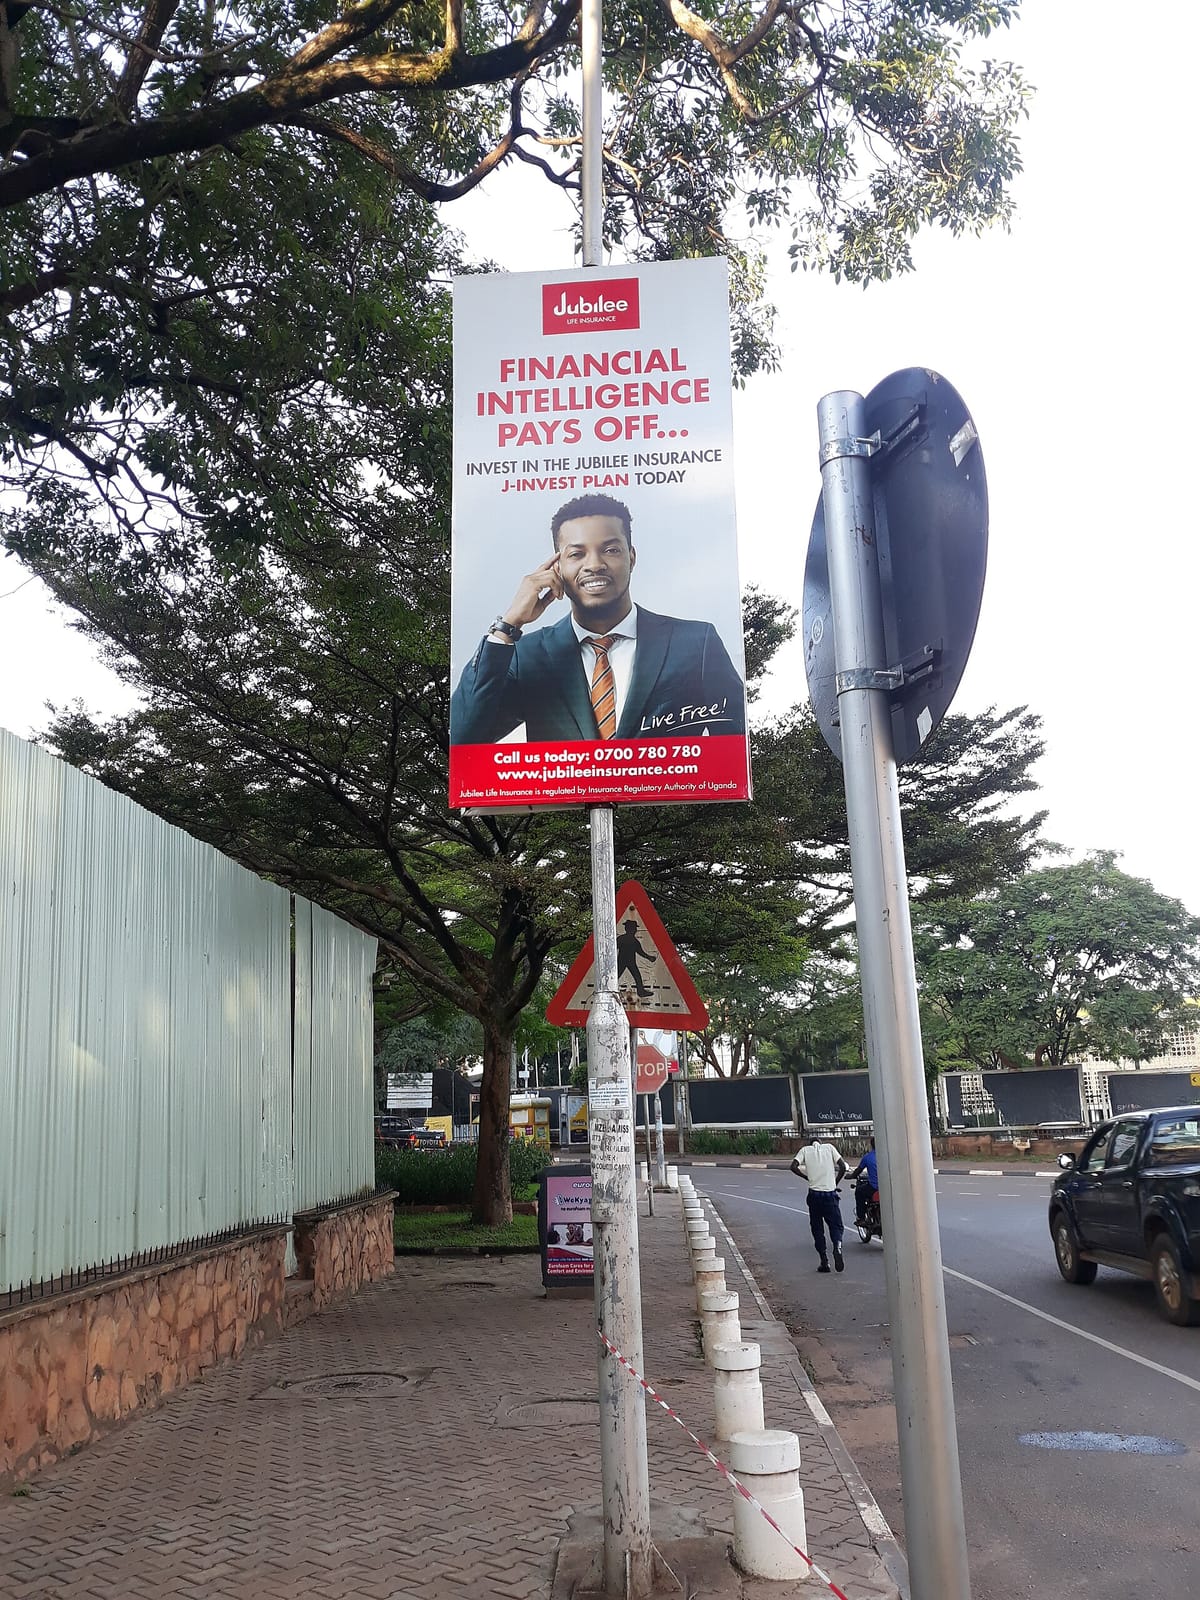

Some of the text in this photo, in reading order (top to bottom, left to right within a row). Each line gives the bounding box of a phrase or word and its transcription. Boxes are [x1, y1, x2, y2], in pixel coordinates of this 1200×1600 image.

[554, 291, 628, 316] Jubilee
[580, 316, 616, 324] INSURANCE
[500, 348, 687, 382] FINANCIAL
[477, 378, 710, 416] INTELLIGENCE
[498, 414, 689, 448] PAYS OFF...
[466, 449, 722, 476] INVEST IN THE JUBILEE INSURANCE
[501, 470, 686, 492] J-INVEST PLAN TODAY
[640, 698, 726, 730] Live Free!
[494, 746, 701, 765] Call us today: 0700 780 780
[497, 763, 698, 782] www.jubileeinsurance.com
[460, 789, 484, 798] Jubilee
[486, 788, 498, 796] Life
[500, 788, 533, 796] Insurance
[542, 786, 576, 796] regulated
[578, 786, 586, 795] by
[588, 785, 622, 794] Insurance
[624, 784, 662, 794] Regulatory
[664, 782, 697, 792] Authority
[698, 782, 706, 790] of
[708, 780, 738, 791] Uganda
[637, 1062, 665, 1076] TOP
